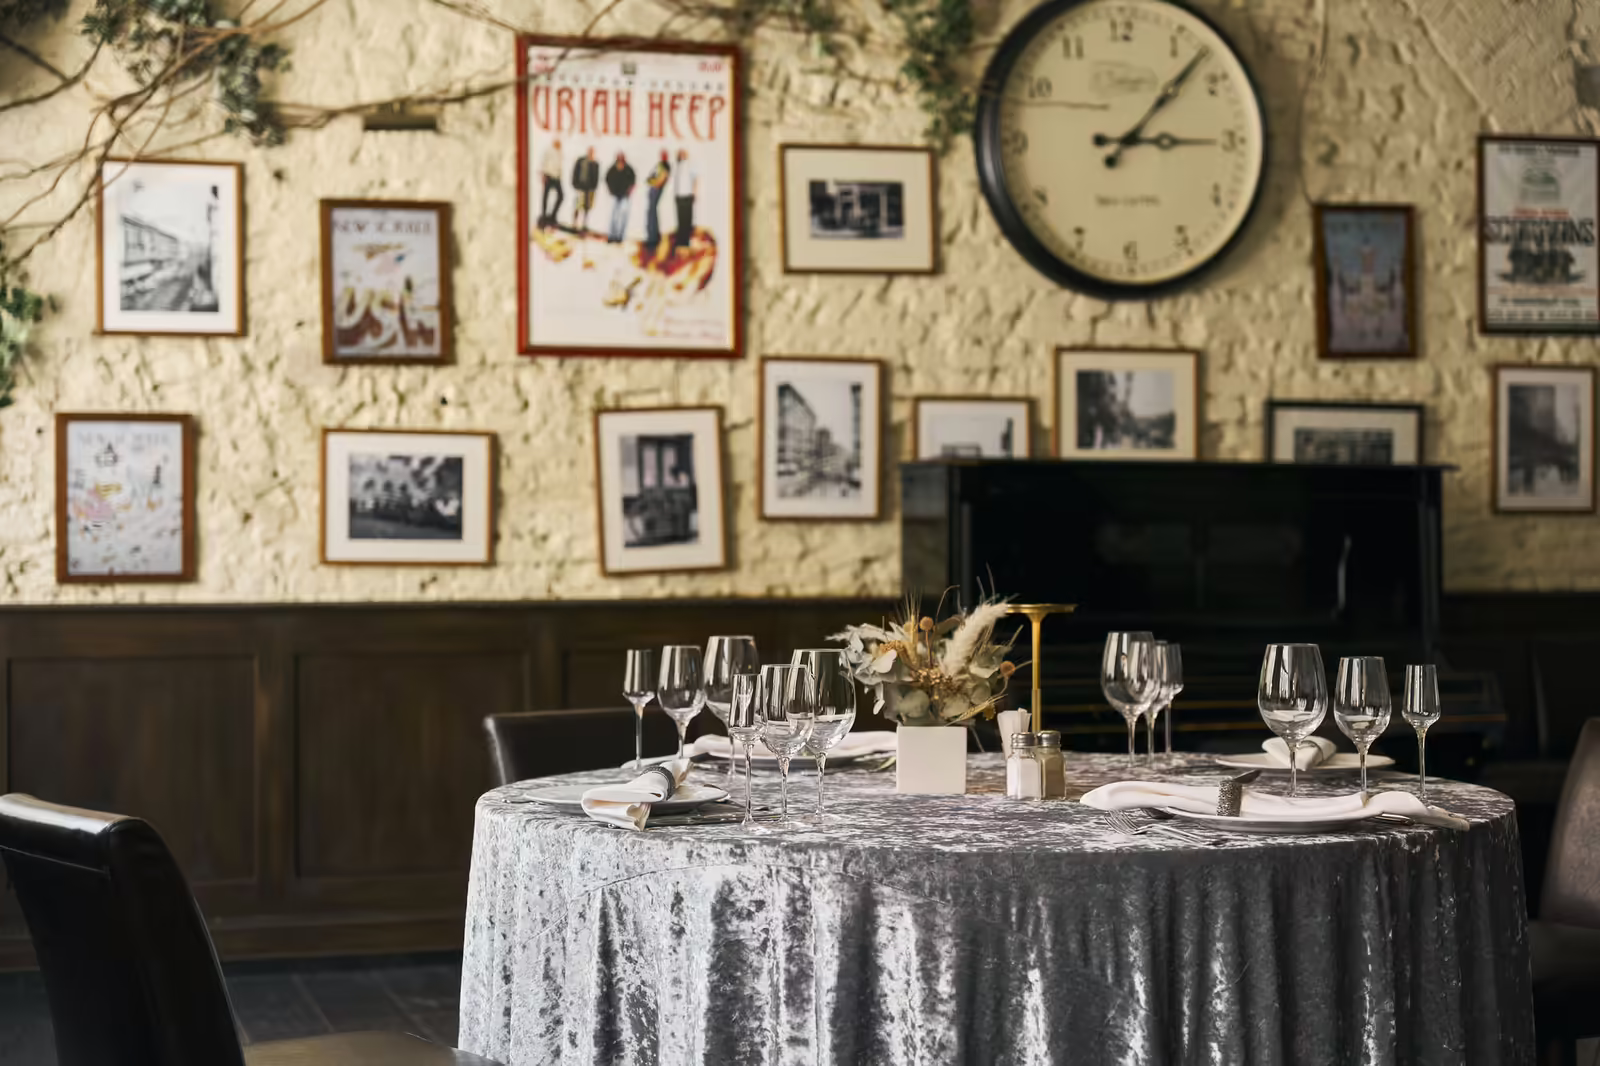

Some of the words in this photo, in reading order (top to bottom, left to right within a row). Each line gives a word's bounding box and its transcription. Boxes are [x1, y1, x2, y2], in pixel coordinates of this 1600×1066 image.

[1110, 20, 1133, 42] 12
[1062, 36, 1084, 59] 11
[1169, 35, 1178, 58] 1
[1027, 77, 1052, 98] 10
[533, 85, 632, 137] URIAH
[647, 91, 727, 141] HEEP
[1220, 130, 1237, 152] 3
[1123, 240, 1138, 261] 6
